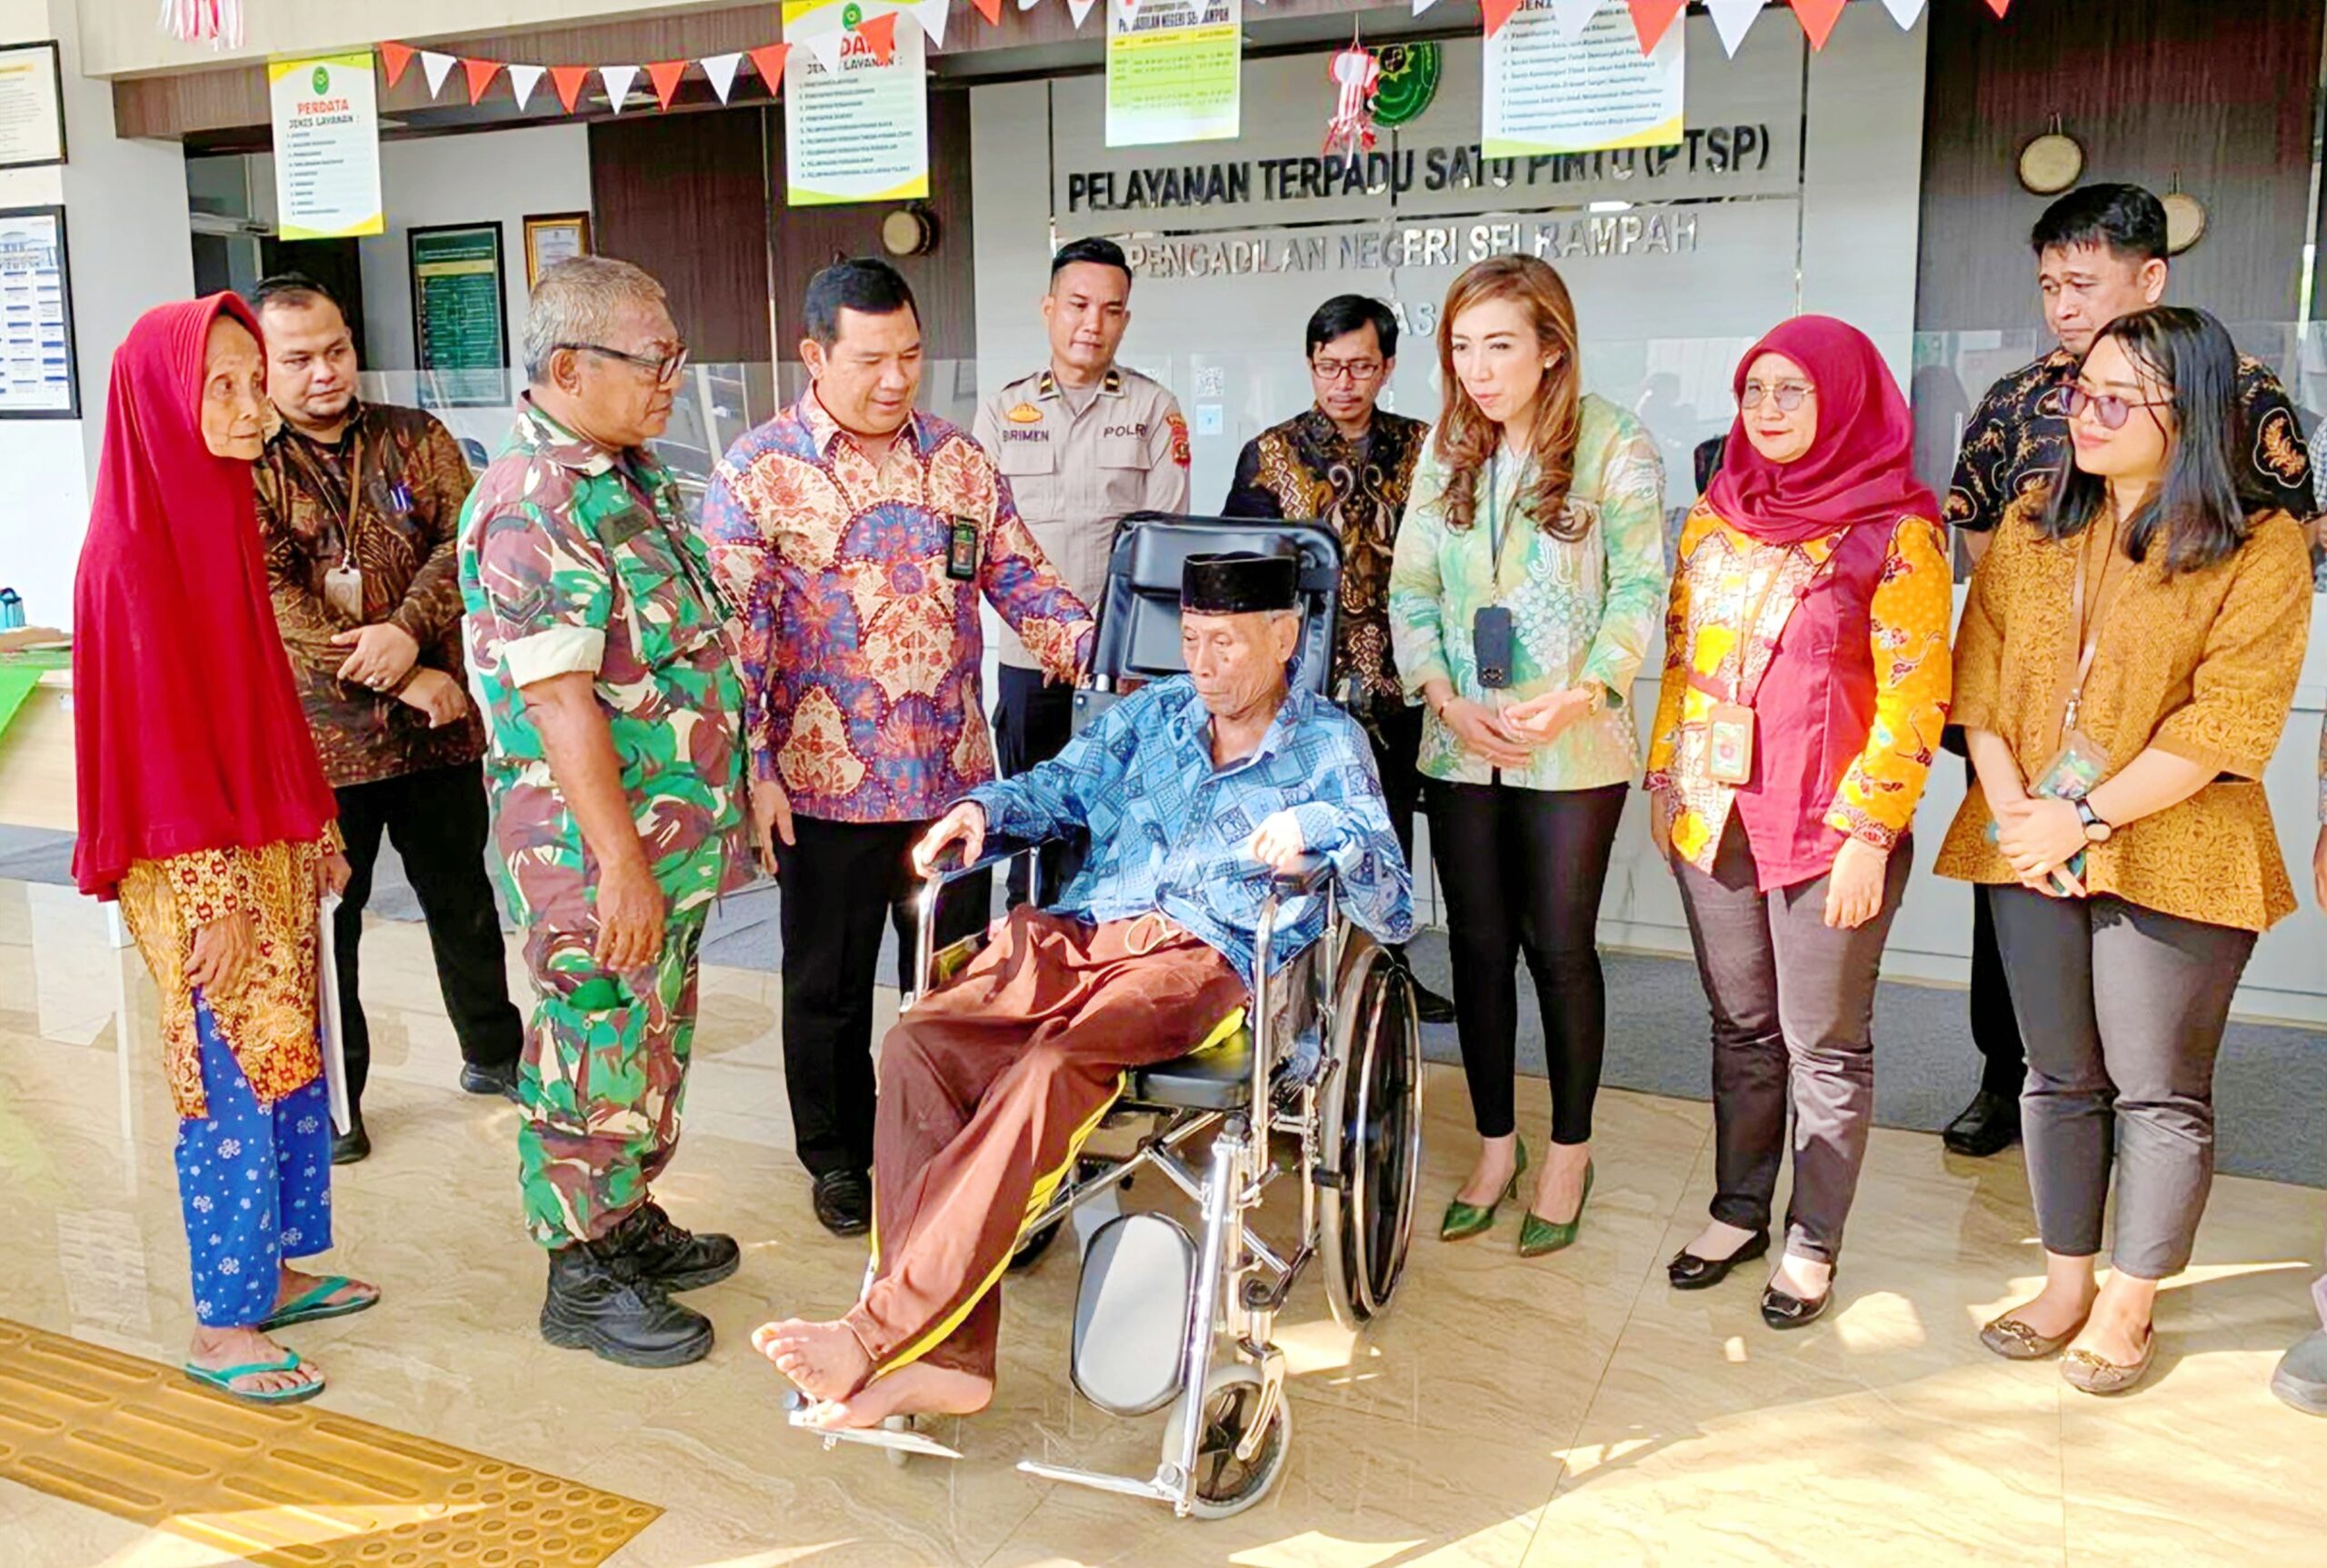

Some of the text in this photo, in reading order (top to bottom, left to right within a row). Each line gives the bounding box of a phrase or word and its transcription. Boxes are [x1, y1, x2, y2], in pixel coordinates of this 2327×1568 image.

[297, 98, 349, 115] PERDATA
[1068, 162, 1251, 213] PELAYANAN
[1258, 148, 1414, 201] TERPADU
[1425, 145, 1513, 192] SATU
[1128, 211, 1698, 280] PENGADILAN NEGERI SEI RAMPAH
